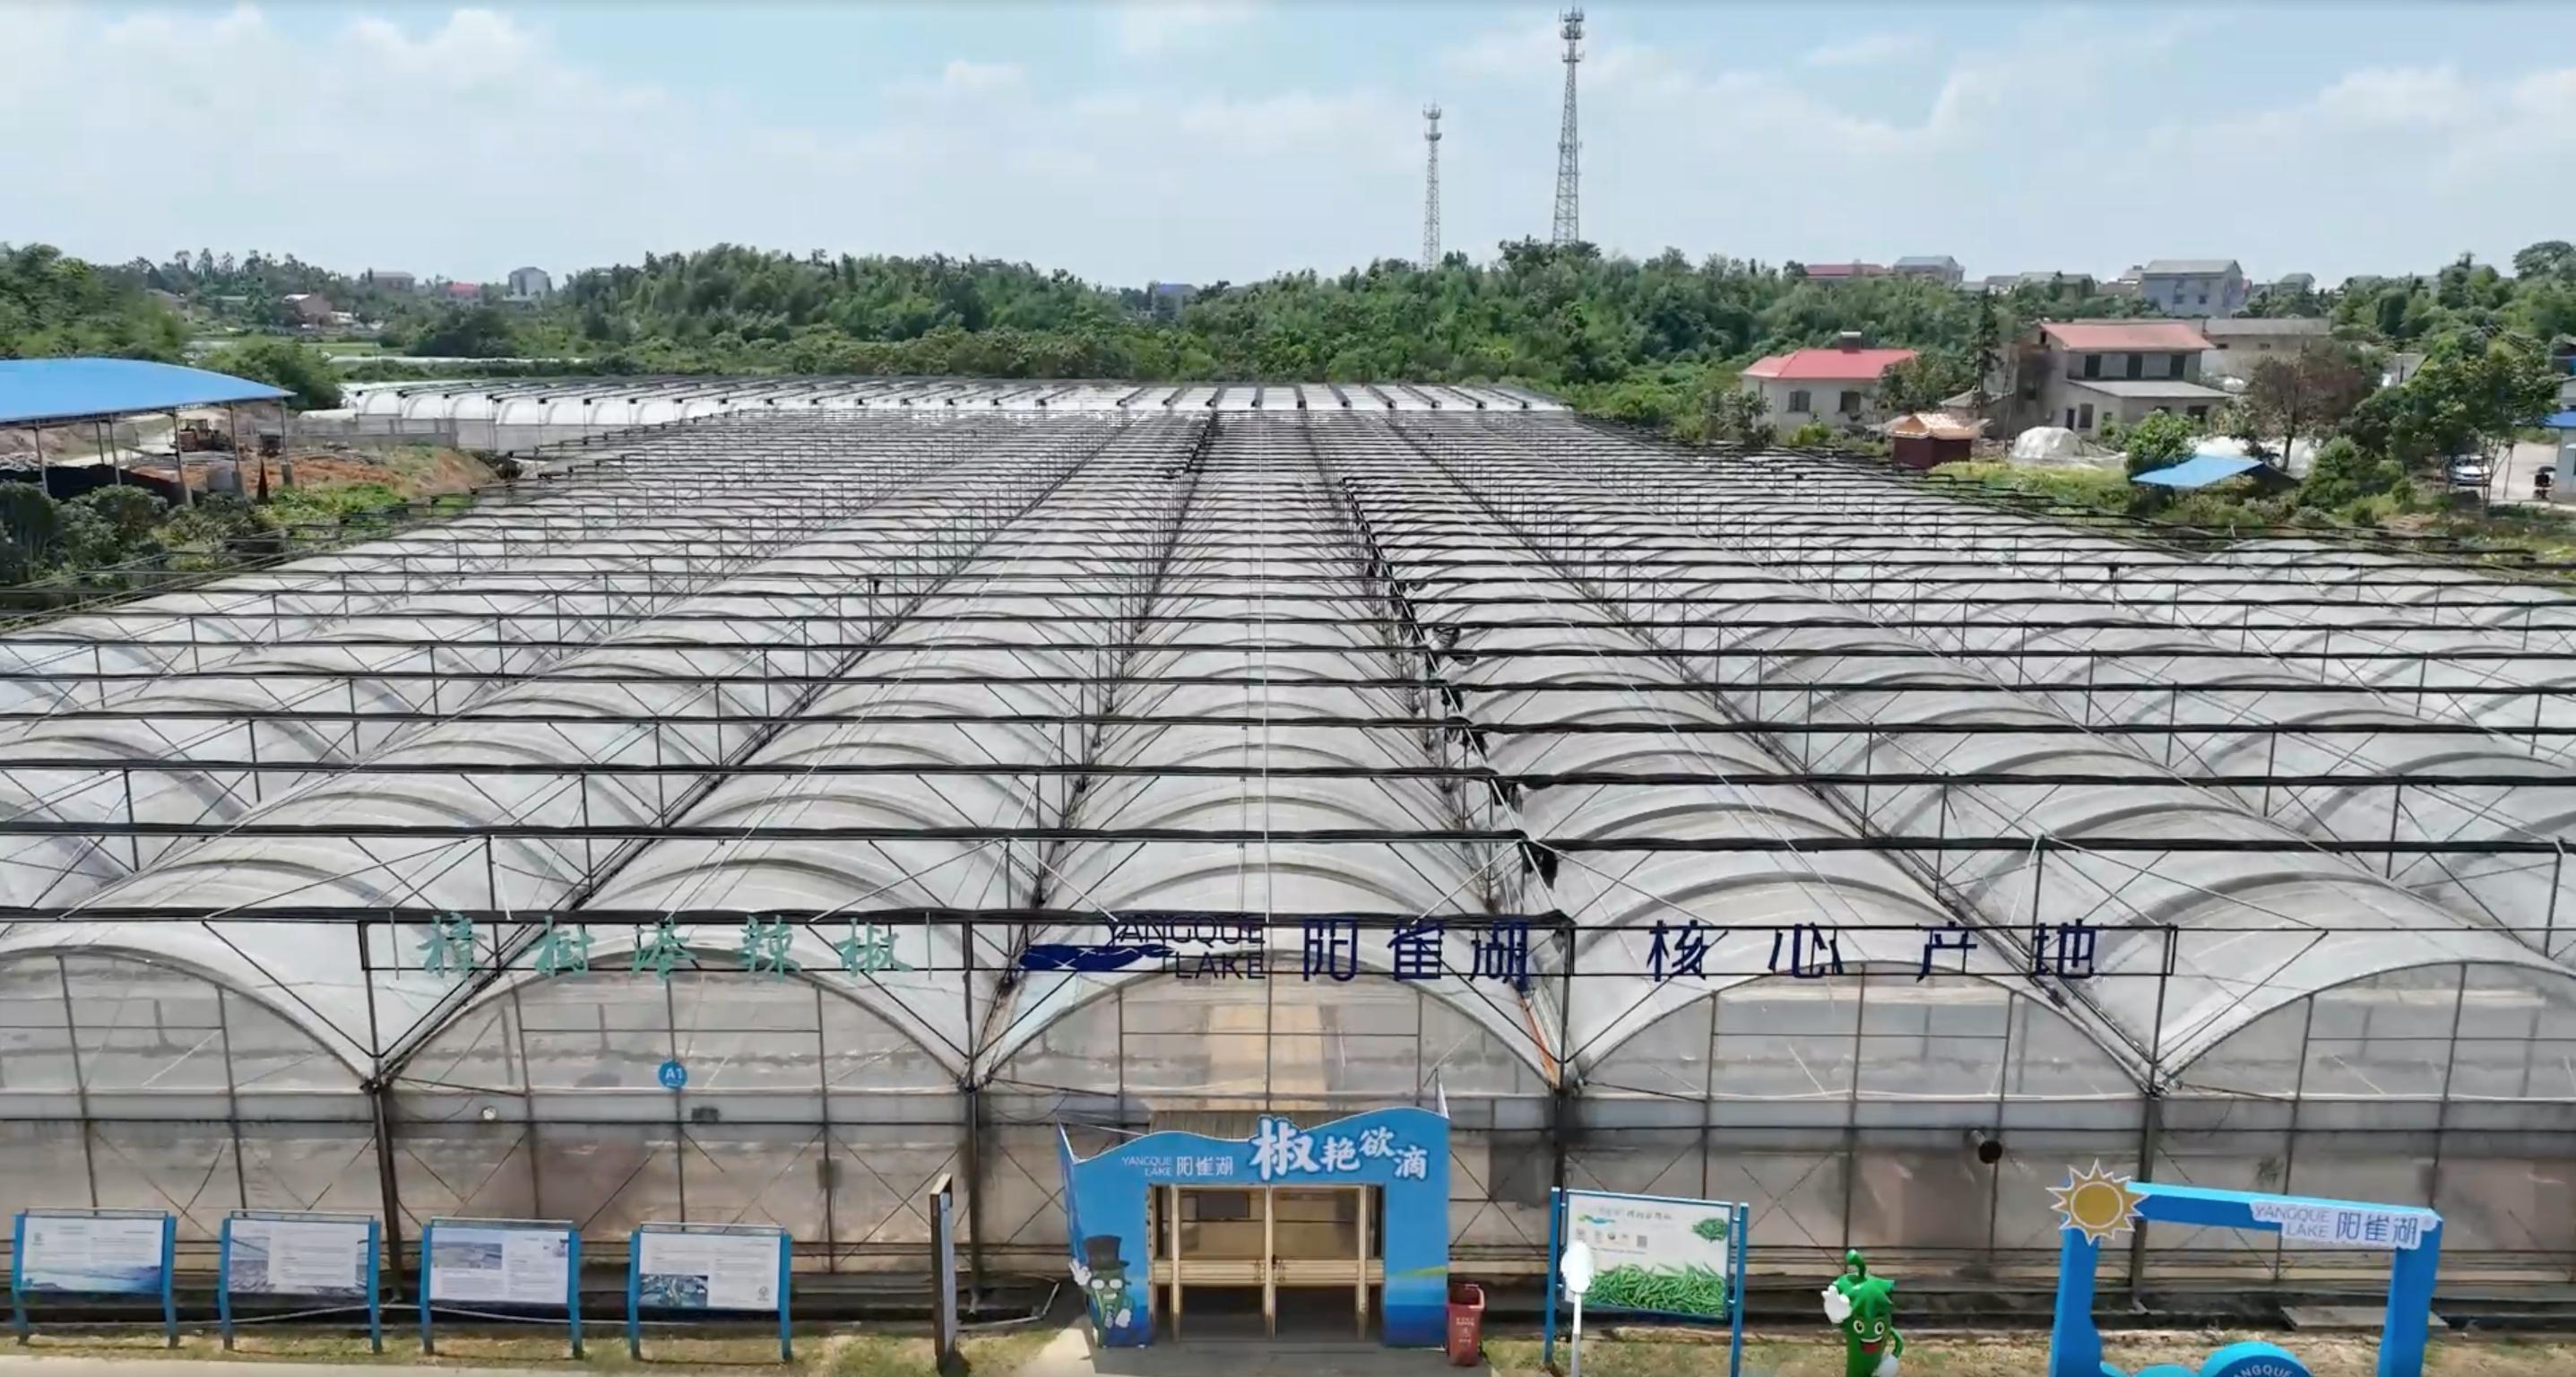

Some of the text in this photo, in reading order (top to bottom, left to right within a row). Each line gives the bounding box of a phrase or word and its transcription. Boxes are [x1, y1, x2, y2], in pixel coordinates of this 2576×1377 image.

[1104, 915, 1266, 948] YANGQUE
[1647, 918, 2096, 983] 核心产地
[1174, 951, 1266, 979] LAKE
[665, 1067, 683, 1079] A1
[1120, 1156, 1173, 1166] YANGQUE
[1248, 1117, 1429, 1182] 椒艳欲滴
[1145, 1166, 1173, 1177] LAKE
[2254, 1204, 2330, 1224] YANGQUE
[2286, 1221, 2330, 1239] LAKE
[2336, 1210, 2419, 1245] 阳雀湖
